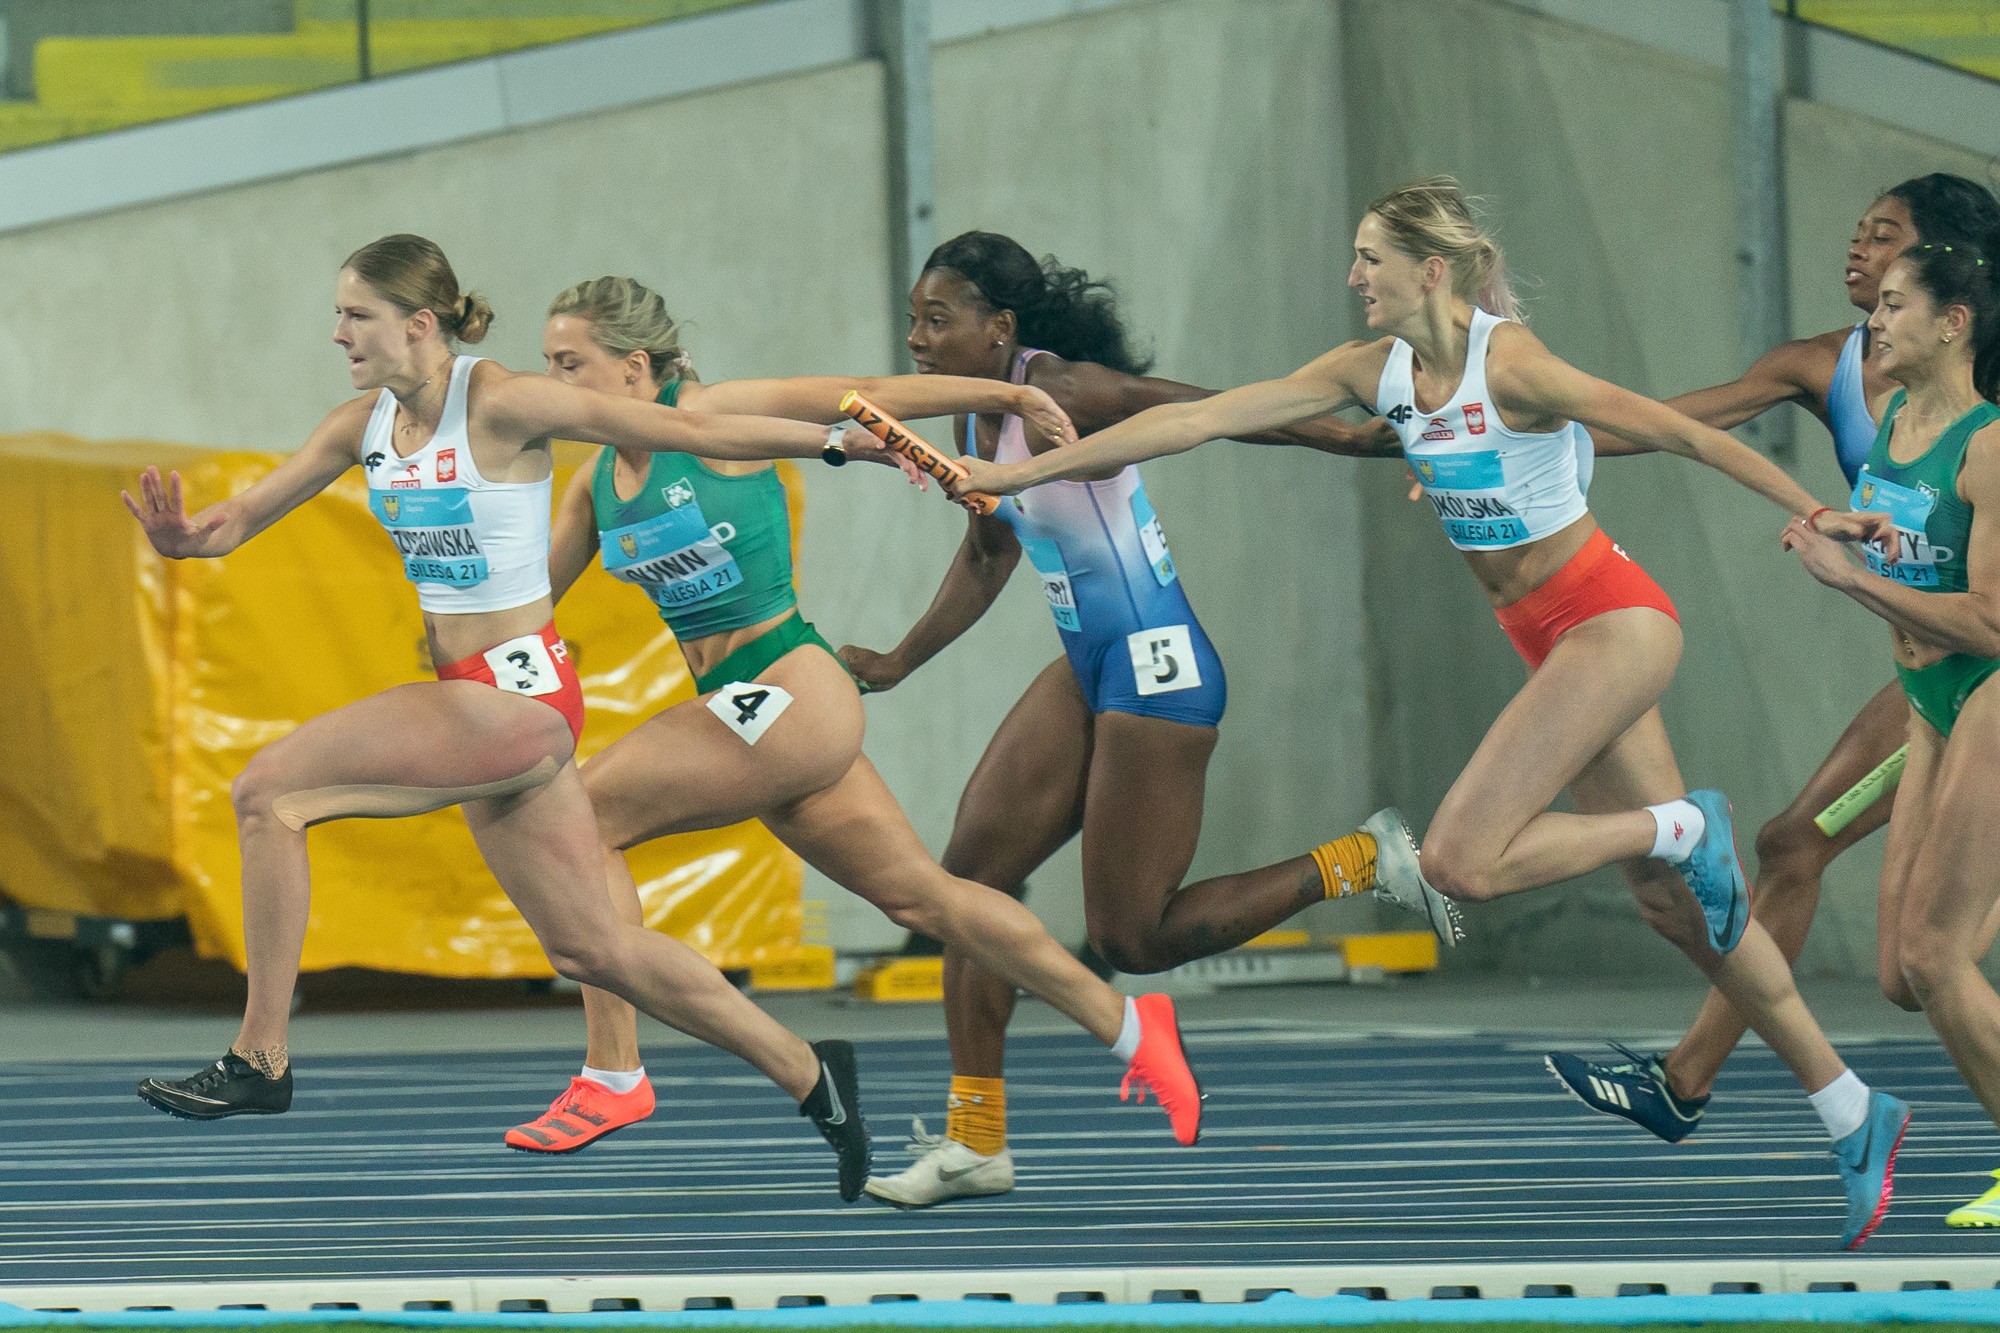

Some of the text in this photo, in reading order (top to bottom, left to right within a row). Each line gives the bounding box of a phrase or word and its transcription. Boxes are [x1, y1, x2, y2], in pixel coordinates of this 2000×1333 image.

[885, 426, 958, 486] ILESIA
[1427, 491, 1513, 519] KÓLSKA
[1500, 523, 1518, 538] 21
[460, 563, 477, 580] 21
[713, 569, 733, 587] 21
[1911, 567, 1929, 581] 21
[506, 650, 539, 689] 3
[1150, 638, 1179, 684] 5
[732, 689, 771, 726] 4
